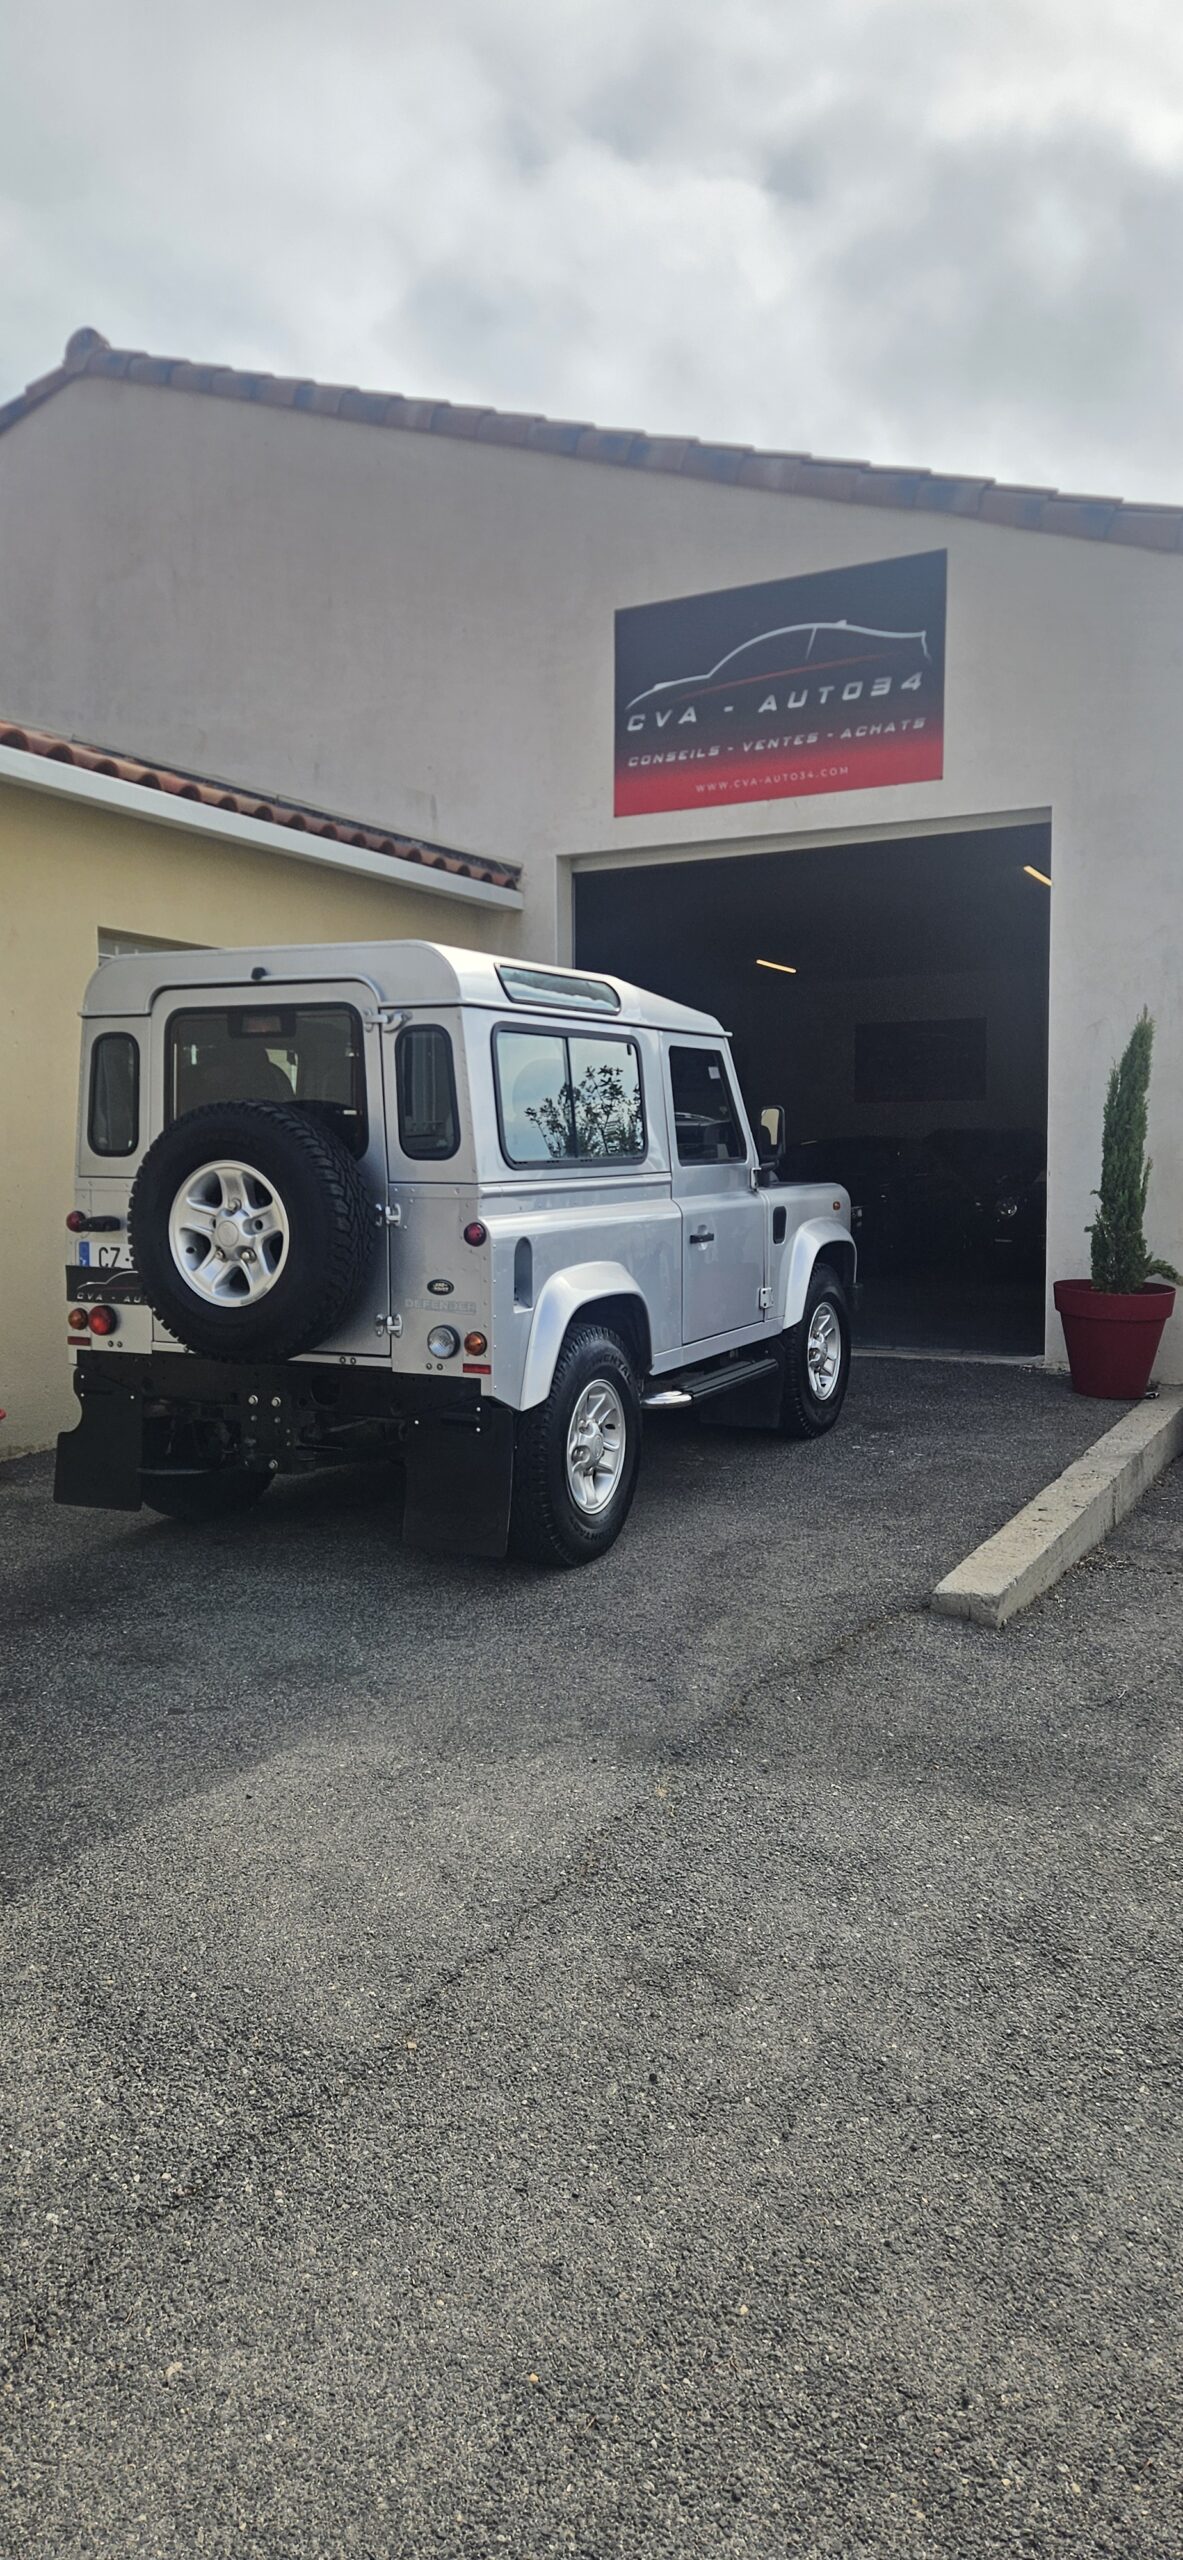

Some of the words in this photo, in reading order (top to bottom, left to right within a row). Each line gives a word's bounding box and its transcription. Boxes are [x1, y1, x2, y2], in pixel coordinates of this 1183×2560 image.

[627, 706, 697, 732] CVA
[758, 671, 922, 713] AUTO34
[628, 745, 720, 767] CONSEILS
[743, 731, 818, 753] VENTES
[840, 717, 926, 740] ACHATS
[695, 766, 849, 793] WWW.CVA-AUTO34.COM
[76, 1292, 103, 1301] CVA
